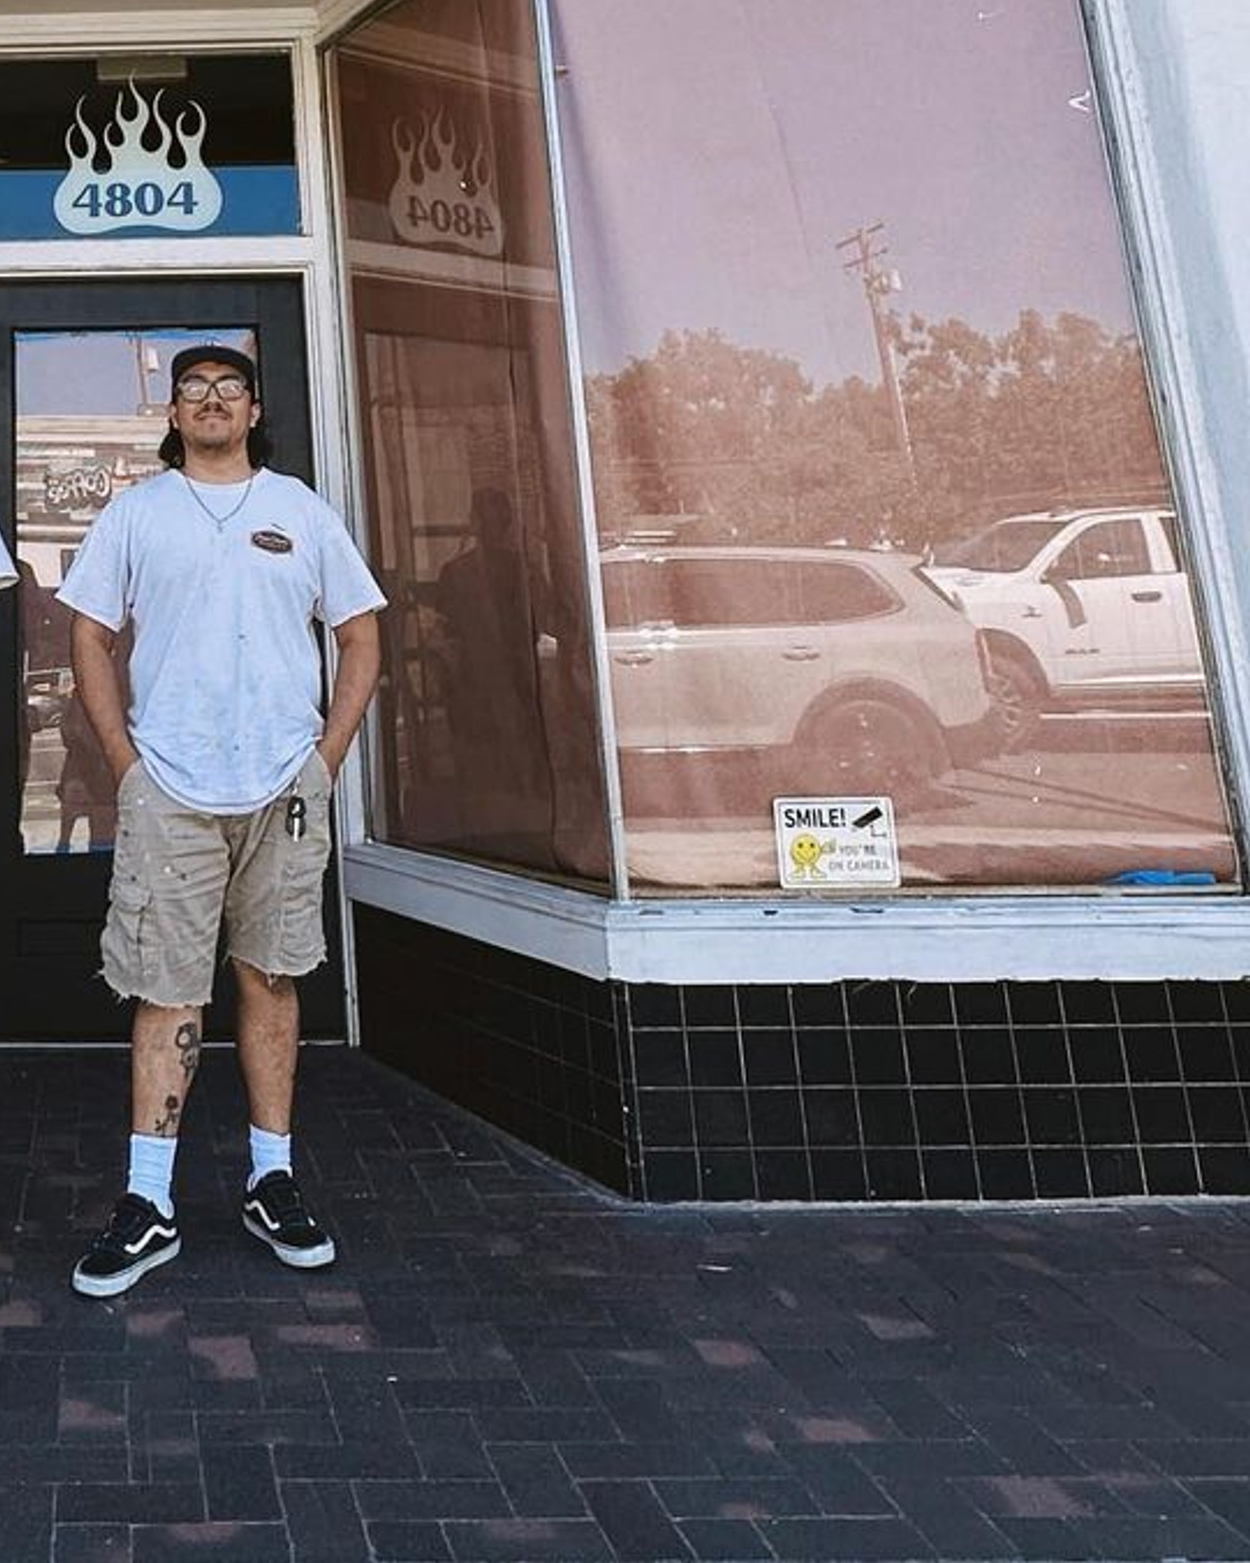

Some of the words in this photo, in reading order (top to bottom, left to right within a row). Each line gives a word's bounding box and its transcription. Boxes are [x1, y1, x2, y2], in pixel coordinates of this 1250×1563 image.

[72, 182, 199, 217] 4804
[784, 807, 846, 829] SMILE!
[839, 843, 877, 856] YOU'RE
[829, 860, 844, 871] ON
[847, 859, 890, 872] CAMERA
